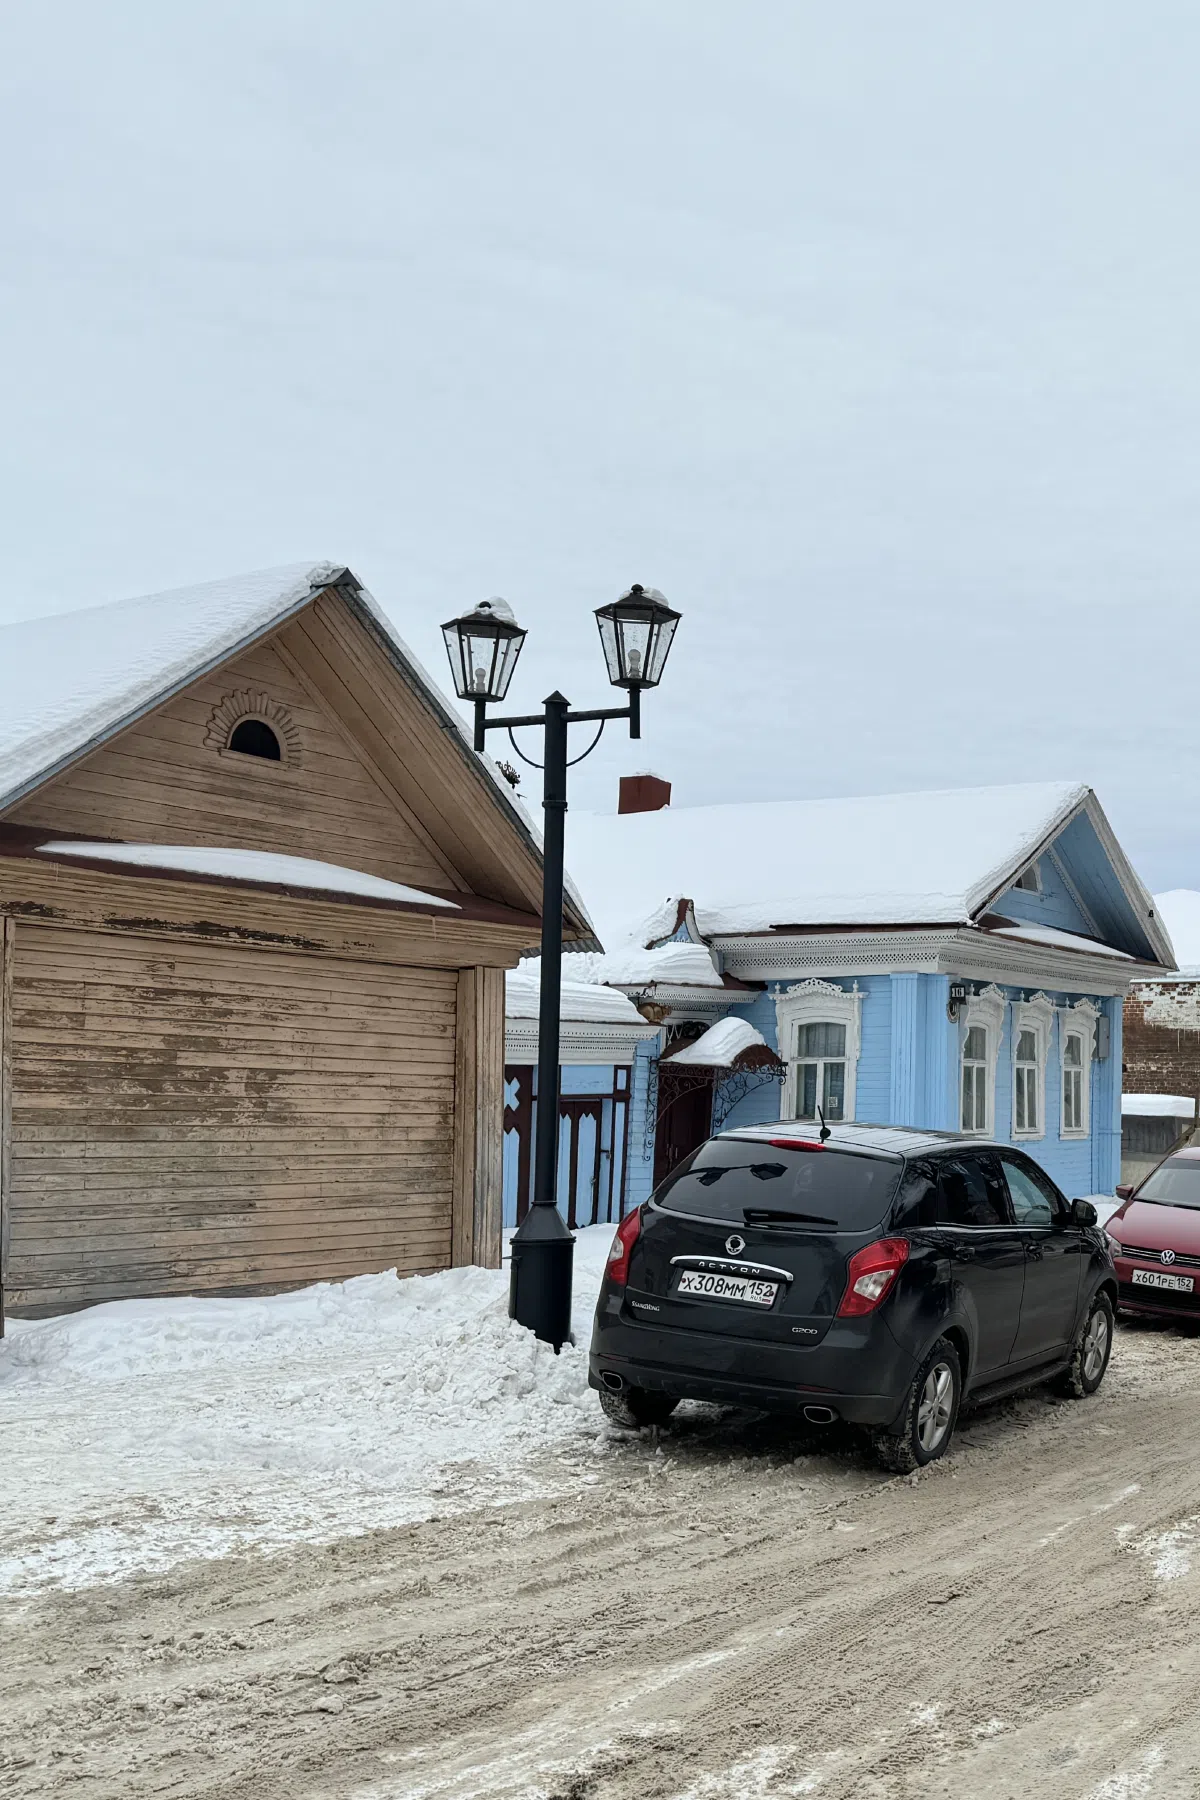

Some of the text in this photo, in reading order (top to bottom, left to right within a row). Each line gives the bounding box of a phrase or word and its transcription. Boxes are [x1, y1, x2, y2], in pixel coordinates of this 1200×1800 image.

[698, 1261, 760, 1274] ACTYON
[683, 1274, 773, 1297] Х308ММ 152
[1176, 1277, 1191, 1287] 152
